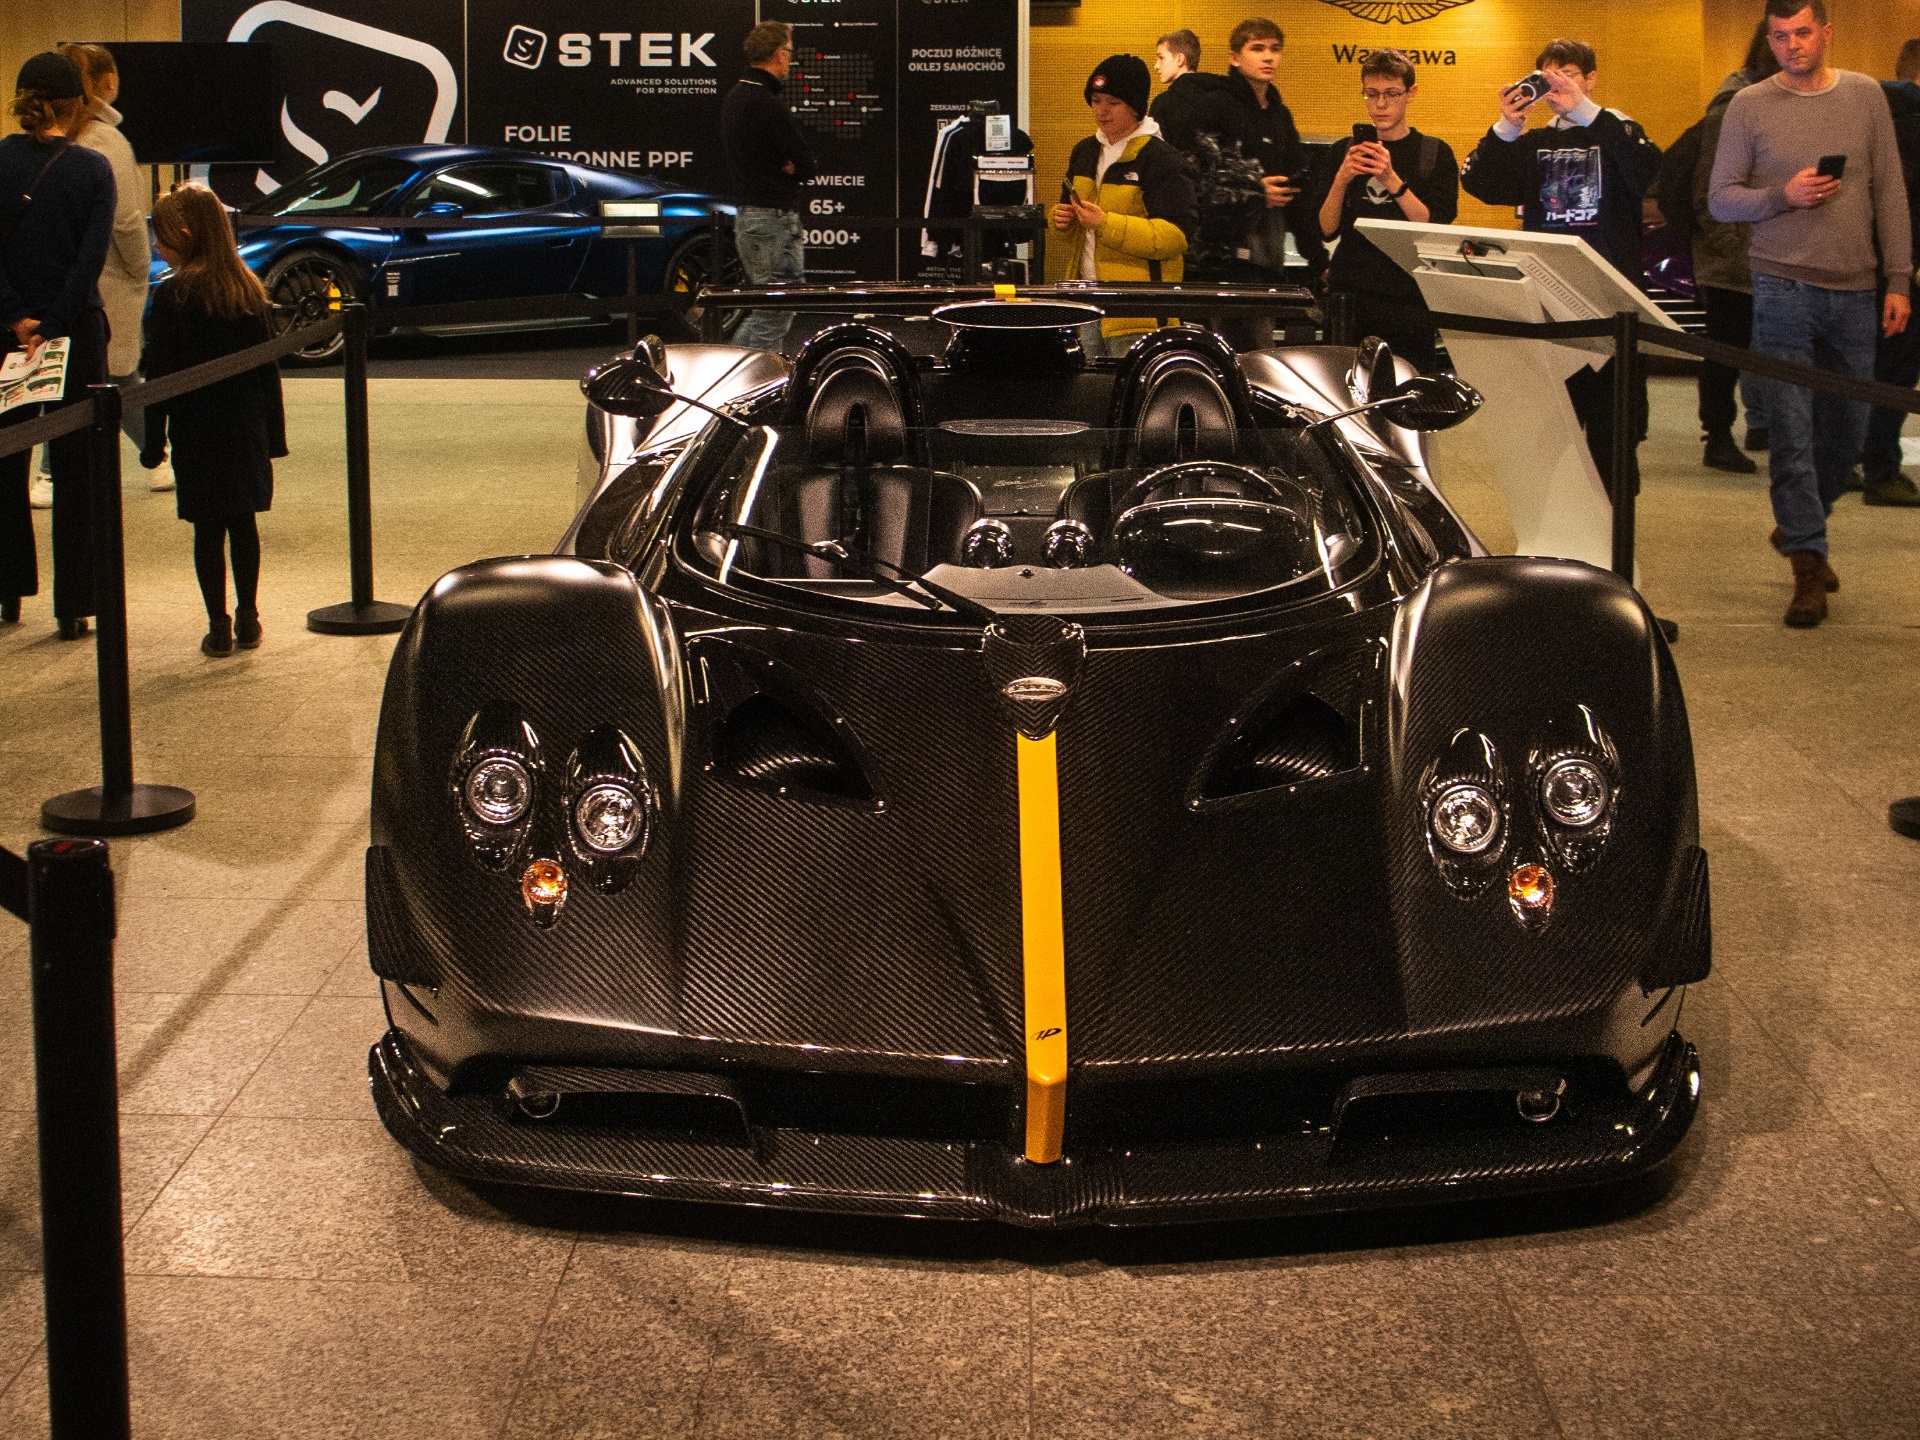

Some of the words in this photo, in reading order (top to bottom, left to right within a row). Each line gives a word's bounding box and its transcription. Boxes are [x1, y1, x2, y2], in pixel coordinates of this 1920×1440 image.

[558, 33, 717, 67] STEK
[911, 48, 953, 58] POCZUJ
[1332, 44, 1456, 65] Waawa
[908, 62, 941, 72] OKLEJ
[943, 60, 1005, 72] SAMOCHÓD
[610, 78, 662, 86] ADVANCED
[664, 78, 717, 86] SOLUTIONS
[504, 125, 571, 142] FOLIE
[648, 151, 694, 168] PPF
[809, 199, 845, 215] 65+
[1546, 208, 1598, 222] ハードコア
